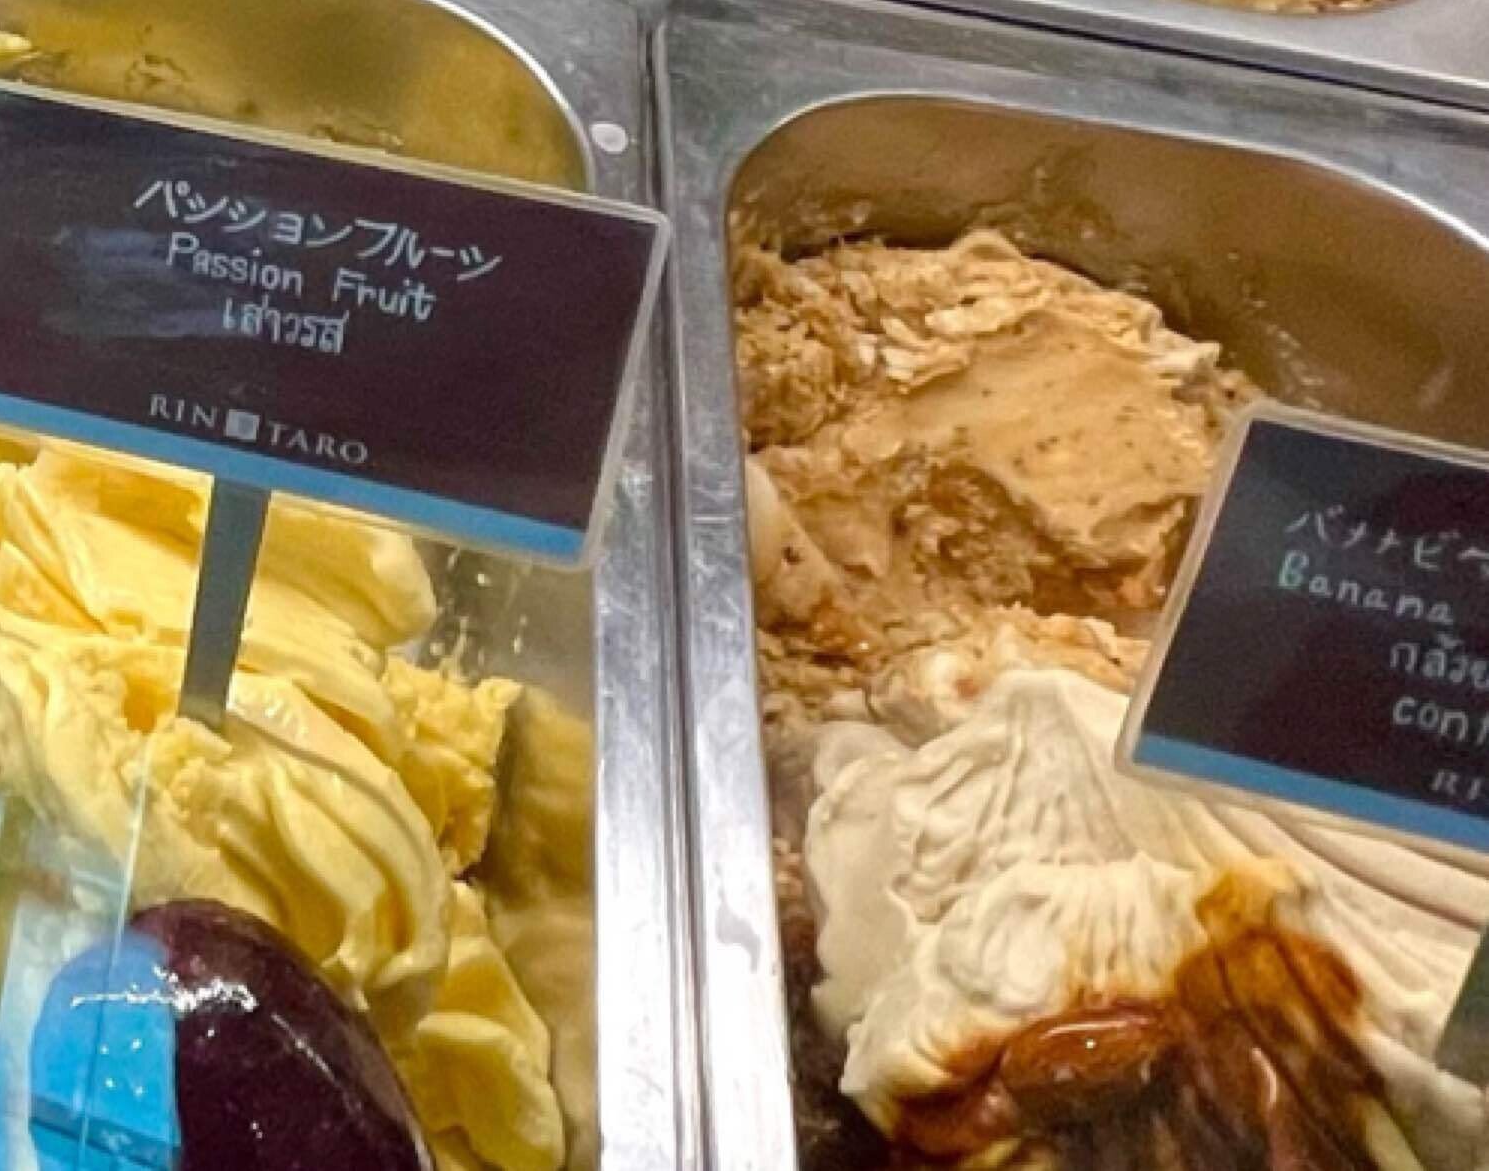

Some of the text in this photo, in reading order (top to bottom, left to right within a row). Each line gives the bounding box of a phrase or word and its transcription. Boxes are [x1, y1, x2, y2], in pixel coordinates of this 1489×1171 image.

[133, 178, 502, 281] パッションフルーツ
[167, 231, 436, 322] Passion Fruit
[149, 392, 368, 465] RIN TARO
[1278, 549, 1455, 627] Banana
